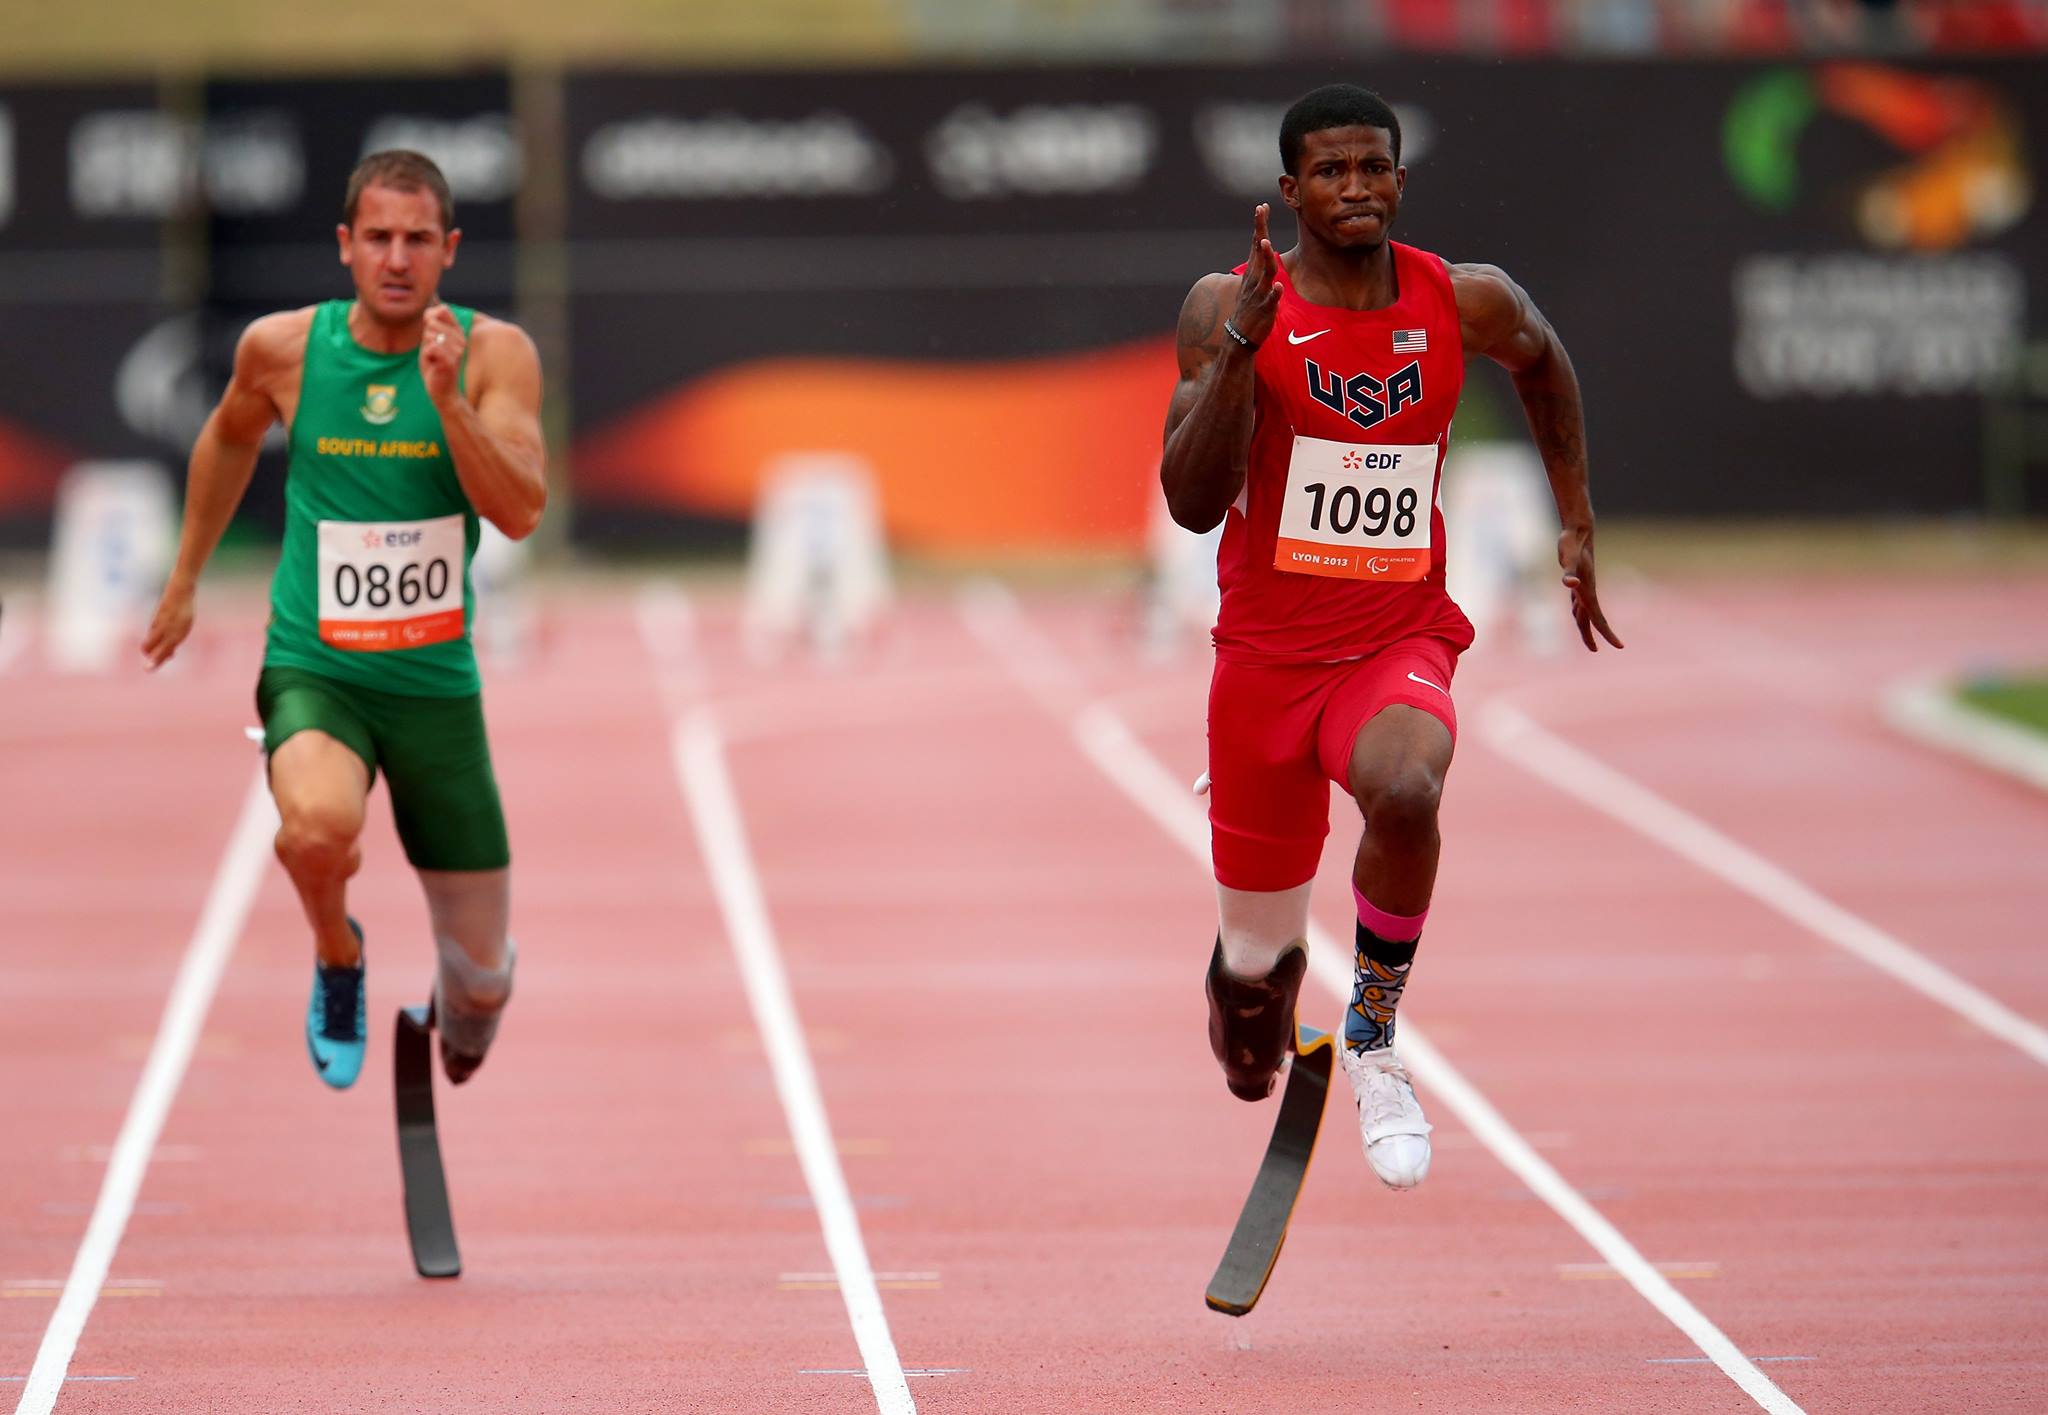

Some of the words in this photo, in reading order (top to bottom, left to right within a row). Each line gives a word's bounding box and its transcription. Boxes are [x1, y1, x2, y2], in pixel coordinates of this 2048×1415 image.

[1305, 357, 1423, 430] USA
[317, 437, 376, 455] SOUTH
[379, 440, 440, 458] AFRICA
[1304, 482, 1418, 538] 1098
[336, 557, 449, 608] 0860
[1292, 551, 1320, 564] LYON
[1323, 556, 1349, 567] 2013
